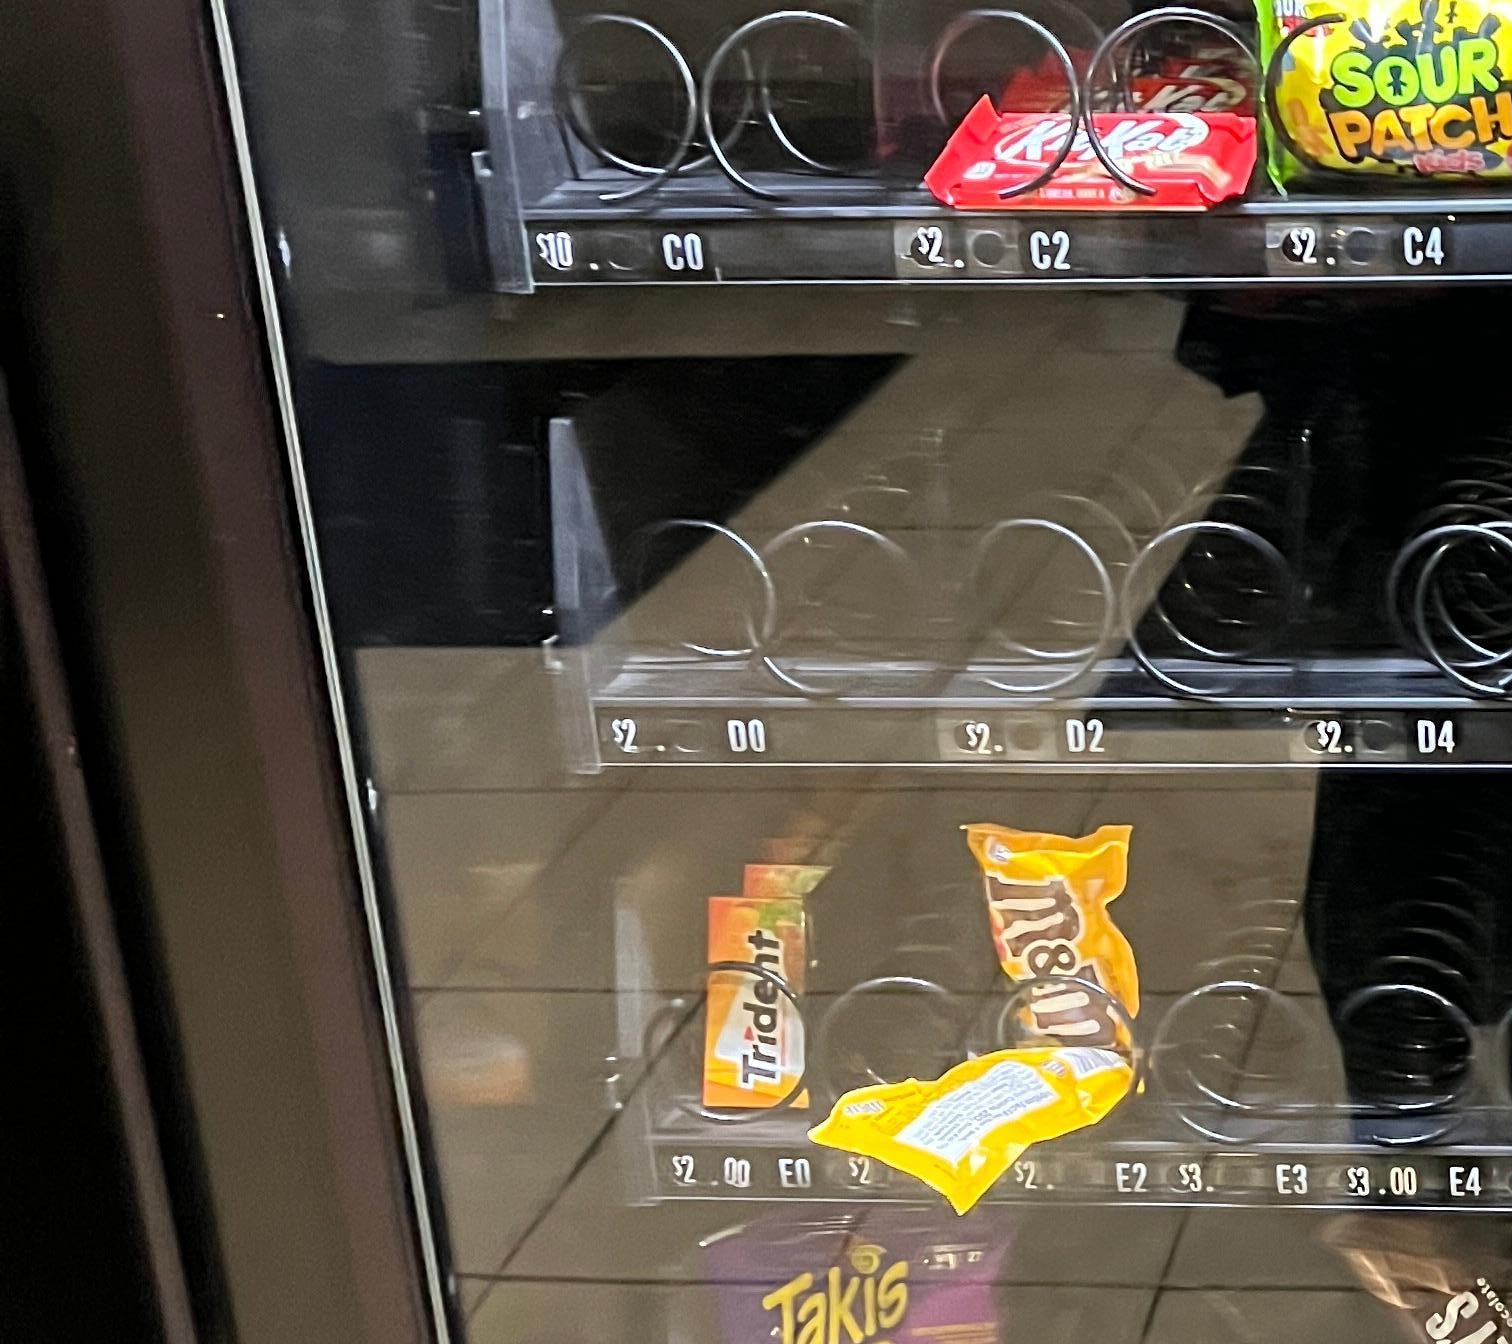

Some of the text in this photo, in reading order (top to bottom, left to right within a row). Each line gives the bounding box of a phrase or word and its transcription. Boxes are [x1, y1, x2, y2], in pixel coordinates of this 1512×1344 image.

[1330, 37, 1500, 108] SOUR
[662, 232, 704, 270] C0
[1029, 230, 1071, 271] C2
[1403, 226, 1445, 266] C4
[727, 719, 766, 754] D0
[1065, 719, 1104, 754] D2
[1416, 719, 1455, 755] D4
[742, 928, 783, 1089] Trident
[1116, 1161, 1149, 1193] E2
[1275, 1164, 1308, 1195] E3
[1449, 1165, 1482, 1196] E4
